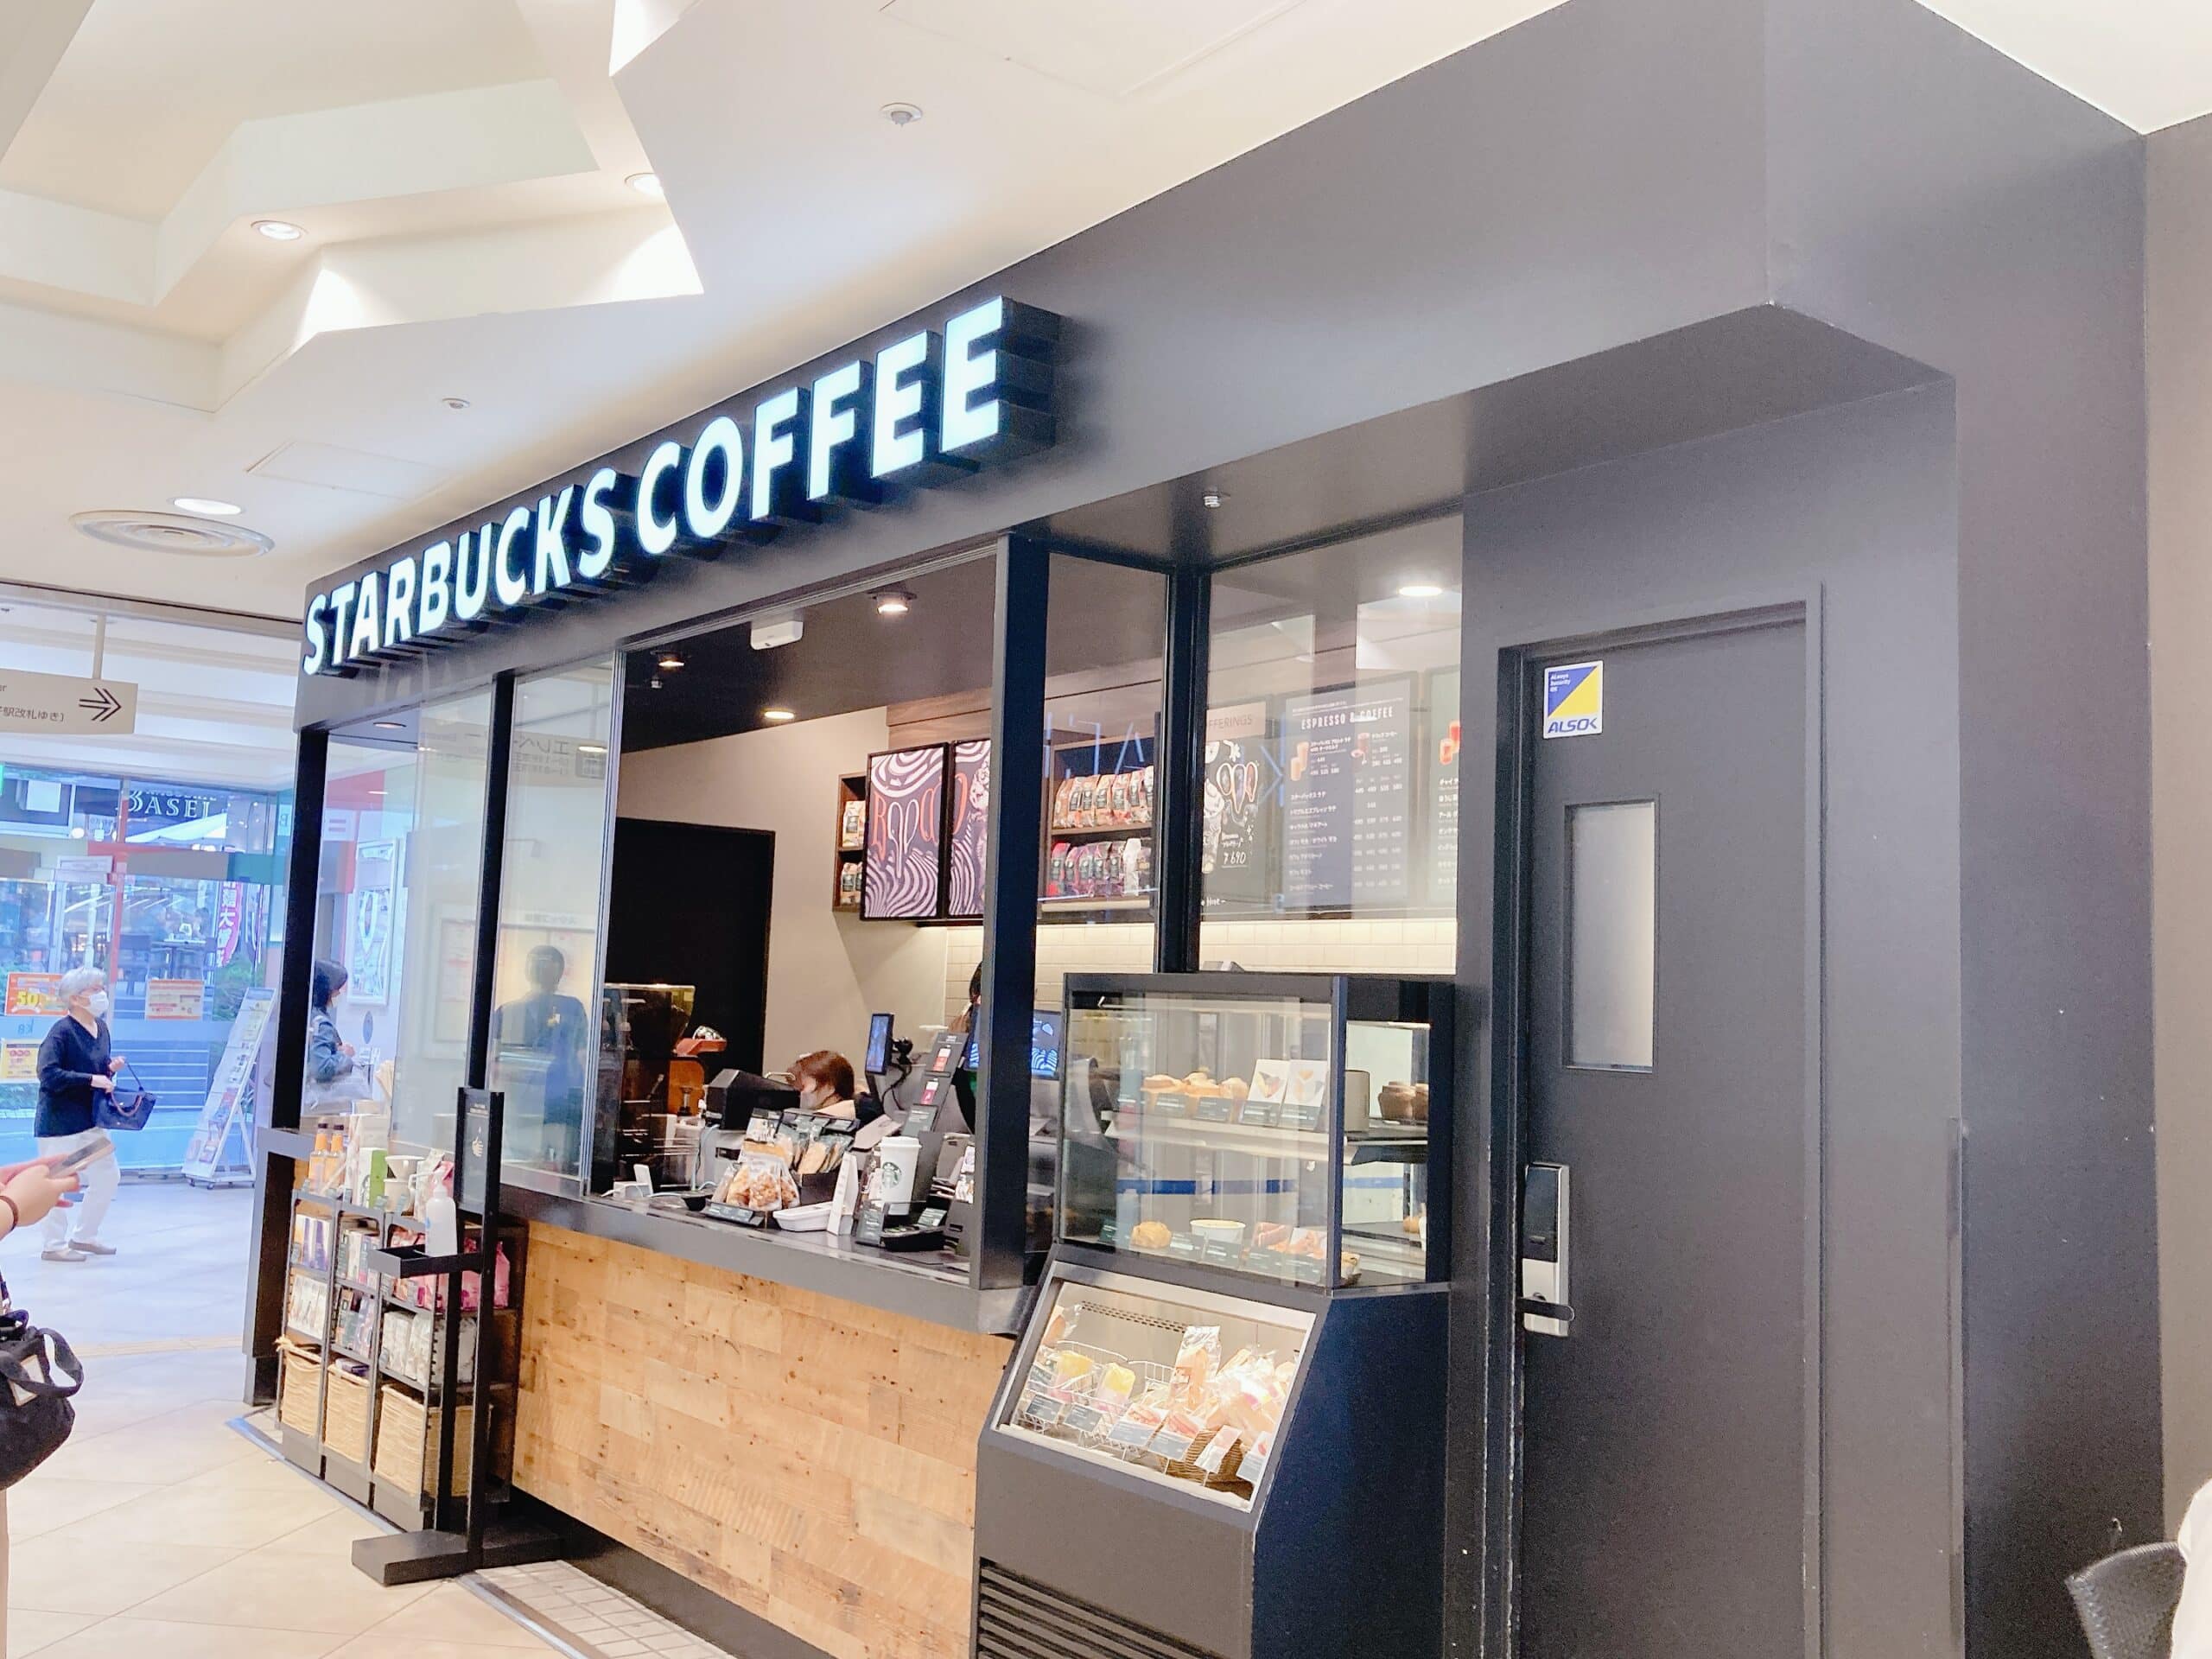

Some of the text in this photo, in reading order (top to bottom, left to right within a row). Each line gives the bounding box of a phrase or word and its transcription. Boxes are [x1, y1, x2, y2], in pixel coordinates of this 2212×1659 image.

[302, 295, 1003, 677] STARBUCKS COFFEE
[1300, 713, 1346, 730] ESPRESSO
[1548, 717, 1598, 734] ALSOK
